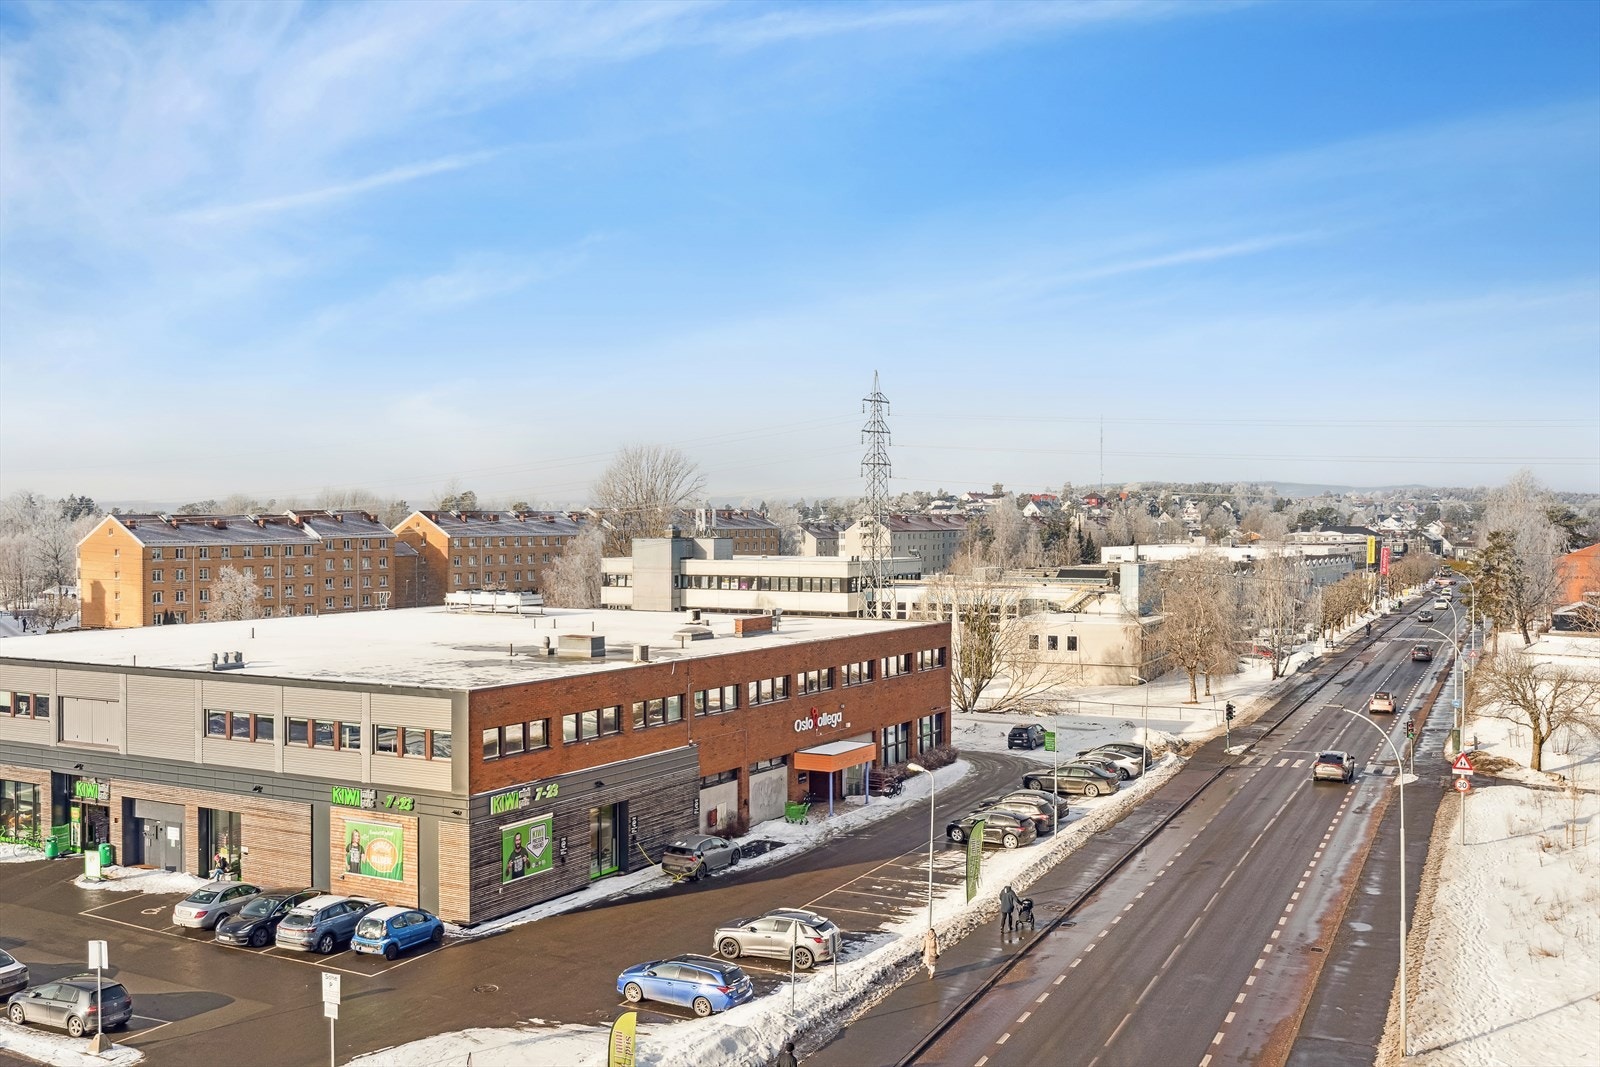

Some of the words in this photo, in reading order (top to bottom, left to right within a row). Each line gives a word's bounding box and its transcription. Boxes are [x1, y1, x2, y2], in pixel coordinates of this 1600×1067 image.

[76, 780, 98, 799] KIWI
[1458, 781, 1467, 789] 30
[331, 785, 360, 807] KIWI
[490, 790, 519, 815] KIWI
[534, 783, 559, 801] 7-23
